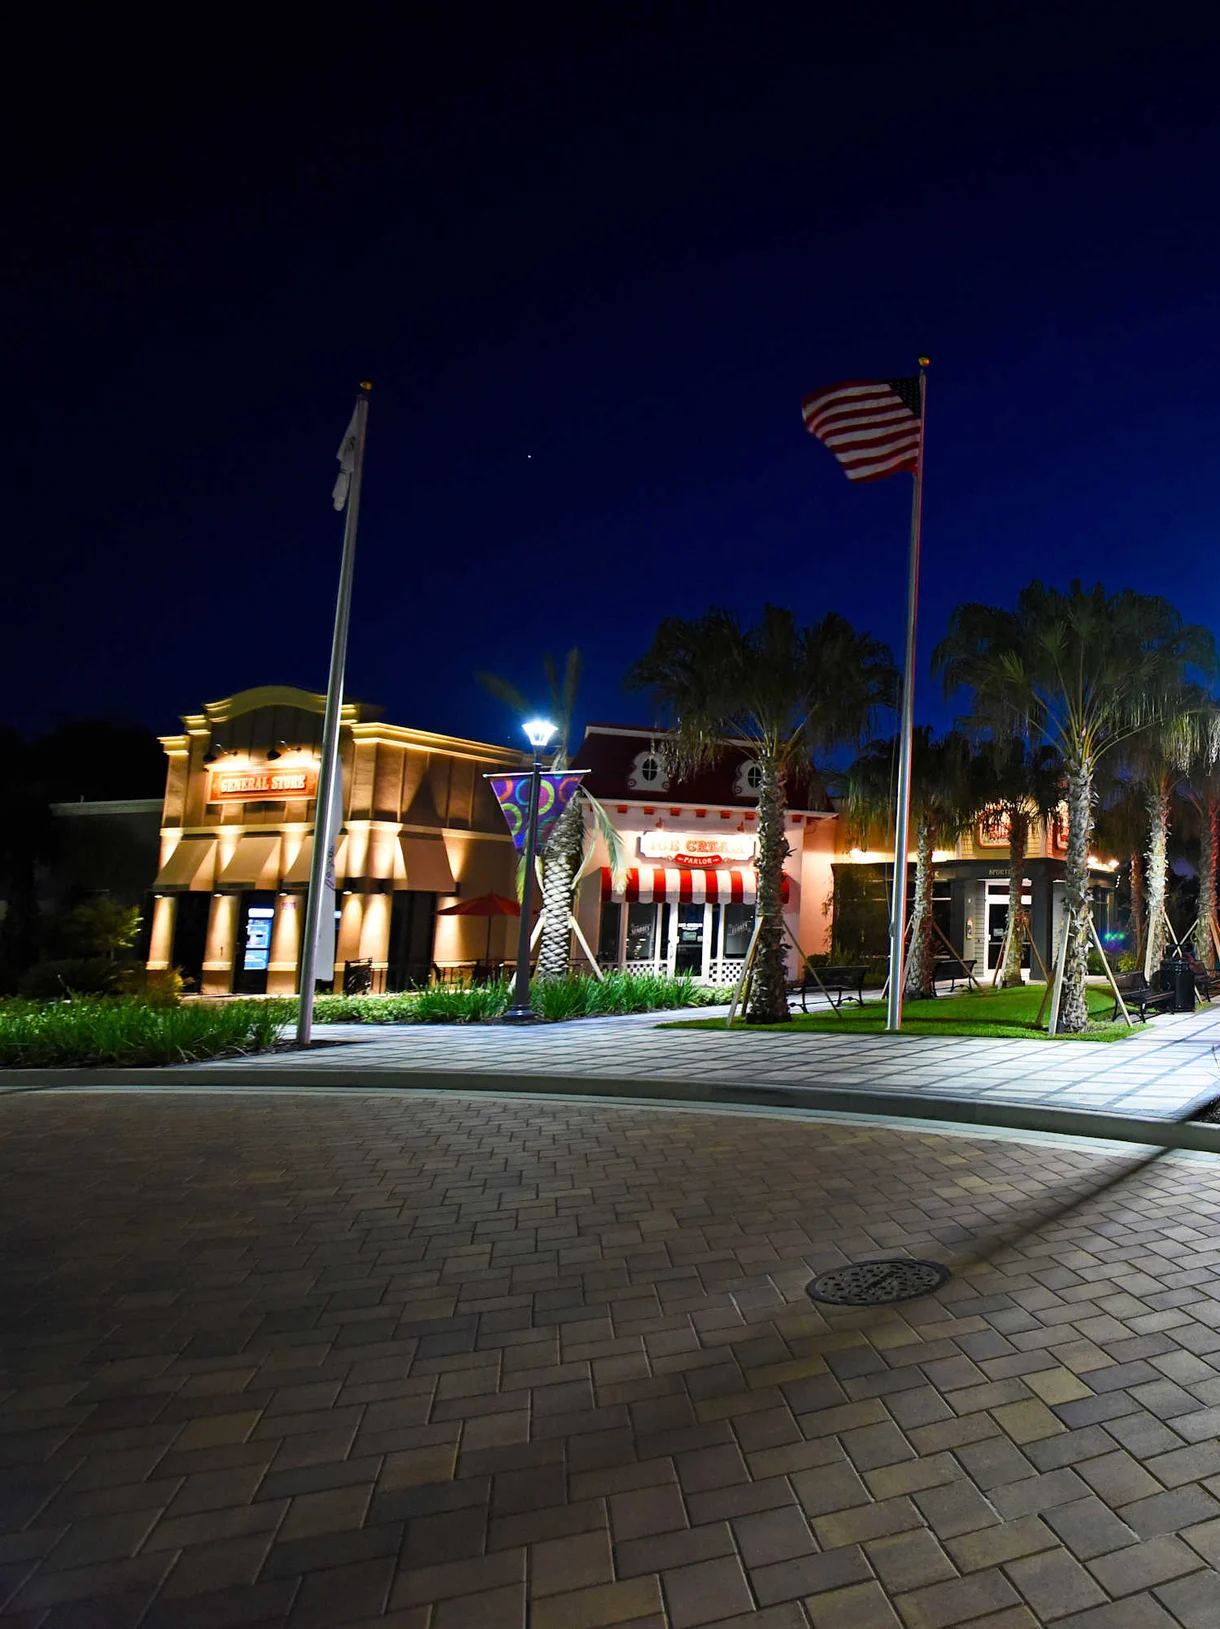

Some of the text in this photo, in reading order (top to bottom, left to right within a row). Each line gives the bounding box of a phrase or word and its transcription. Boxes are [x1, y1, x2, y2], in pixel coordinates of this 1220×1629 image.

[221, 775, 306, 793] GENERAL STORE
[647, 840, 680, 852] ICE
[683, 857, 713, 865] PARLOR
